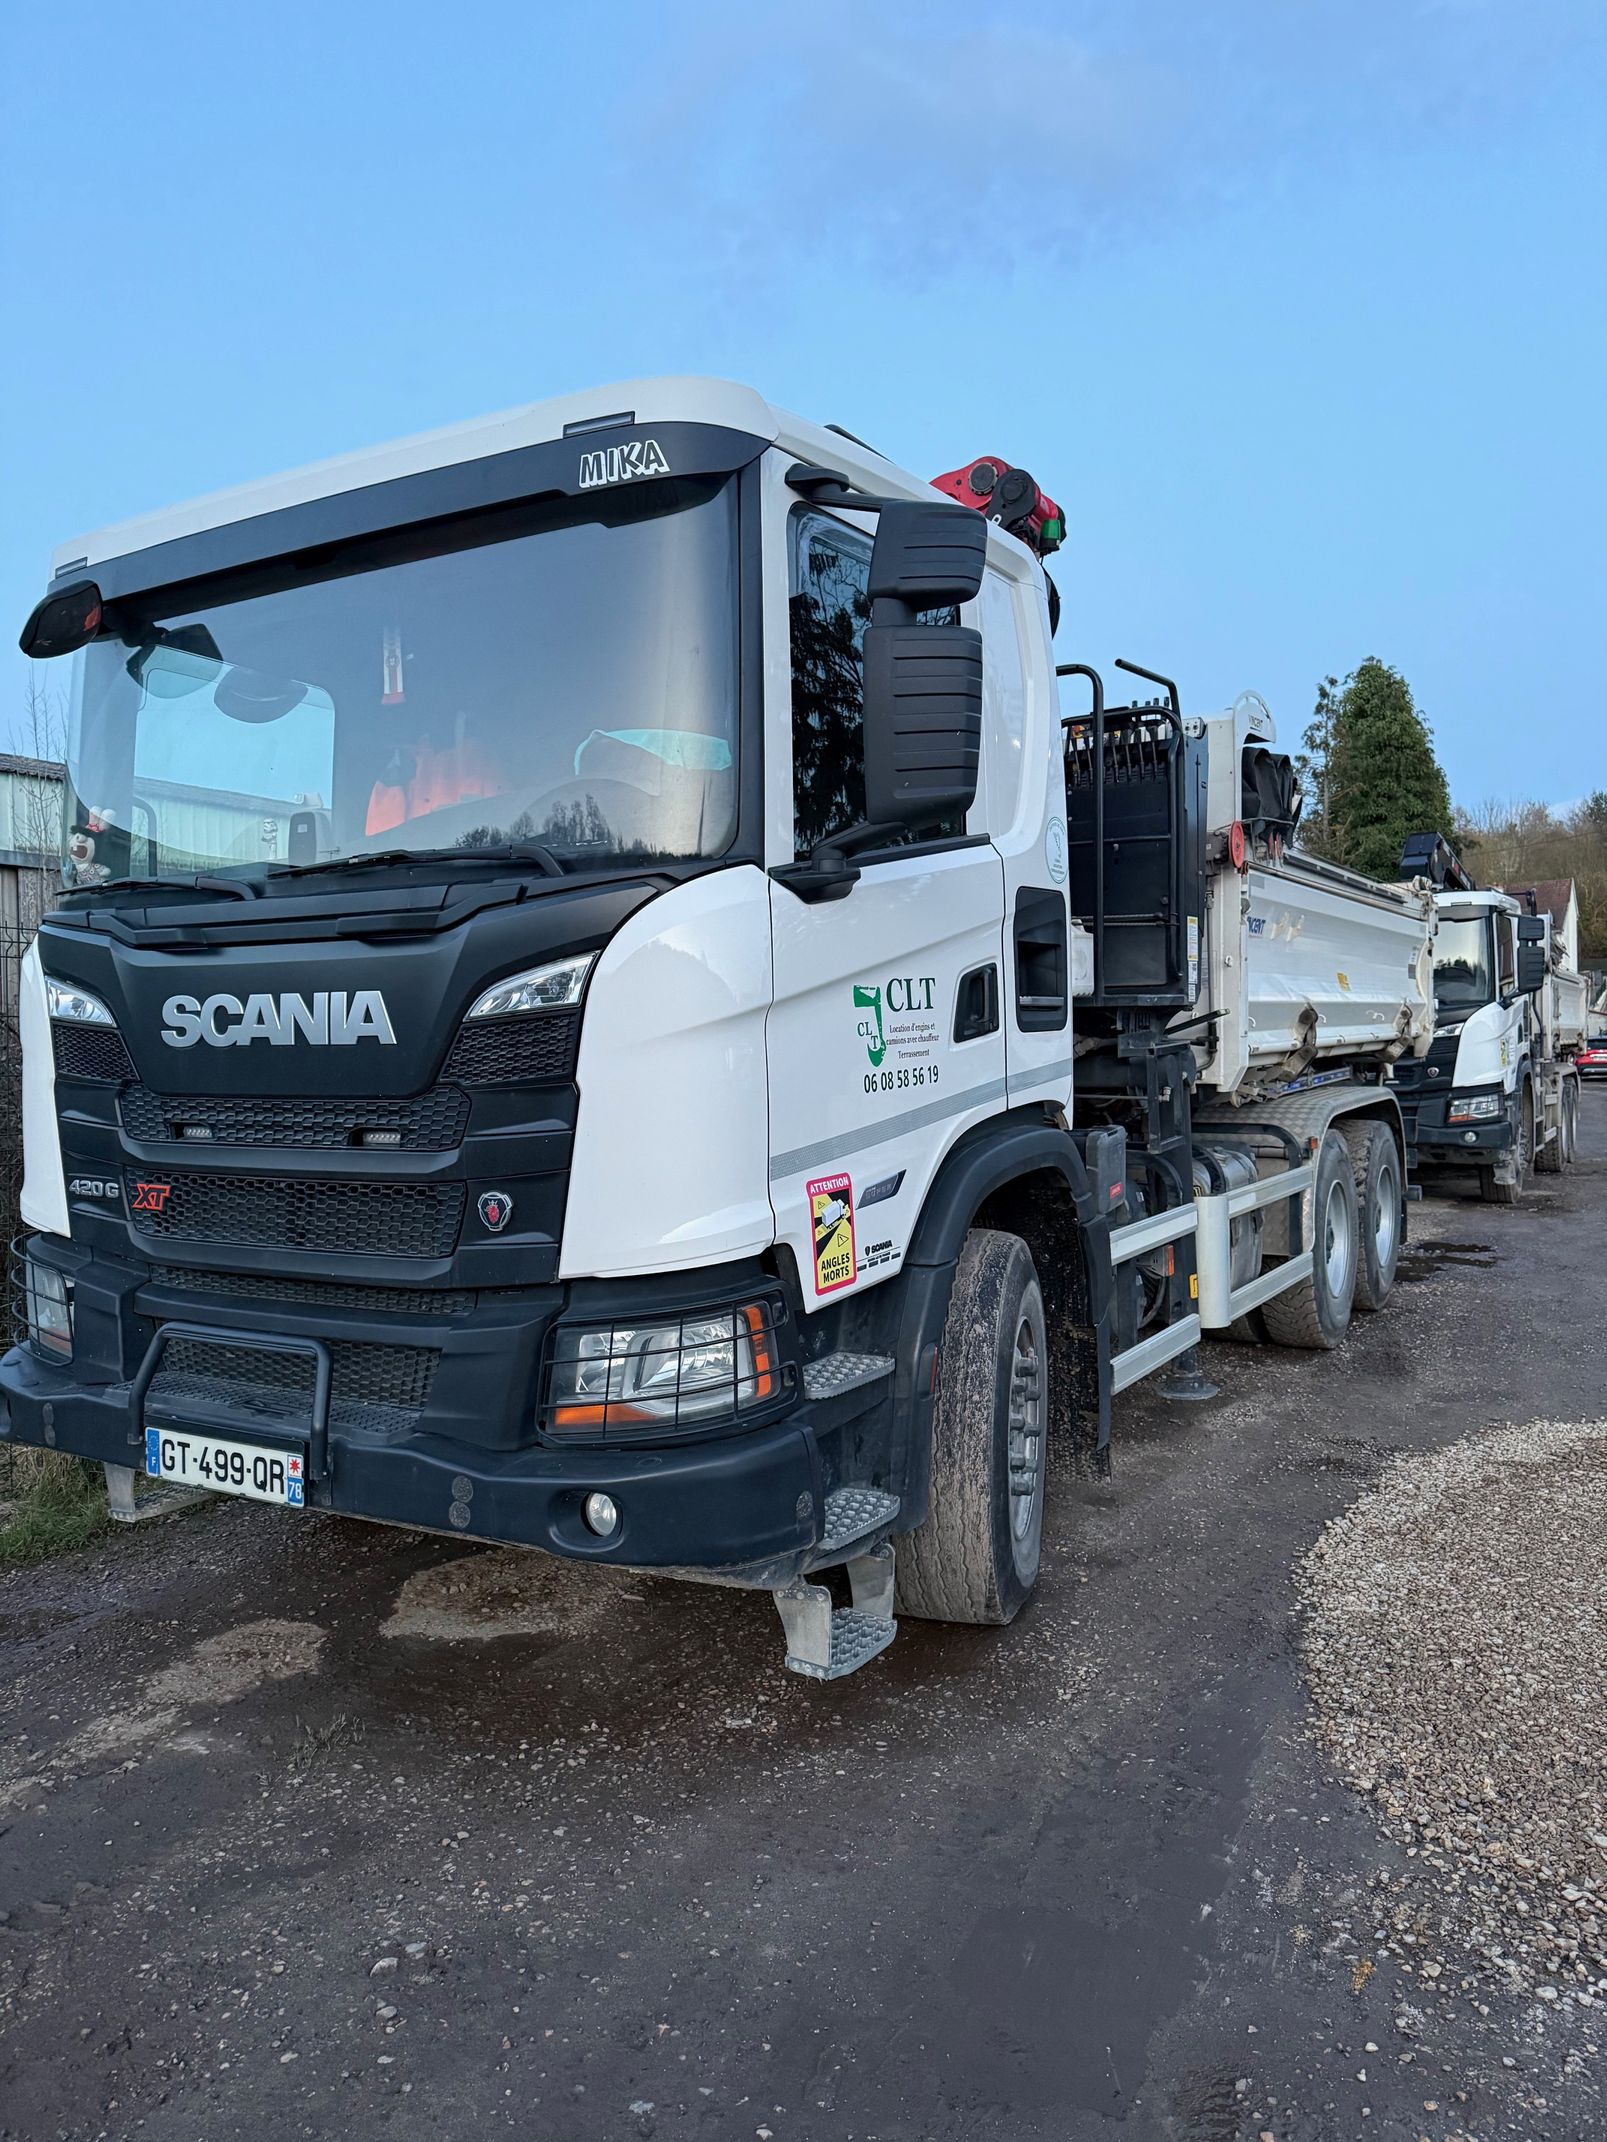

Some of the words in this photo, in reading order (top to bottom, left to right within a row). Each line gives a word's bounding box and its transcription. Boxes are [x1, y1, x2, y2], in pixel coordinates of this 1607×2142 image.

[579, 439, 671, 489] MIKA
[886, 977, 936, 1012] CLT
[160, 990, 398, 1048] SCANIA
[889, 1024, 910, 1034] Location
[886, 1036, 906, 1046] camions
[907, 1035, 917, 1044] avec
[918, 1034, 940, 1043] chauffeur
[898, 1048, 930, 1059] Terrassement
[864, 1073, 877, 1093] 06
[881, 1071, 894, 1091] 08
[897, 1069, 909, 1089] 58
[913, 1066, 925, 1086] 56
[928, 1064, 939, 1083] 19
[810, 1176, 849, 1194] ATTENTION
[132, 1183, 170, 1211] XT
[871, 1239, 893, 1254] SCANIA
[821, 1252, 850, 1271] ANGLES
[823, 1265, 850, 1284] MORTS
[151, 1456, 157, 1466] F
[161, 1438, 285, 1495] GT-499-QR
[288, 1481, 302, 1499] 78
